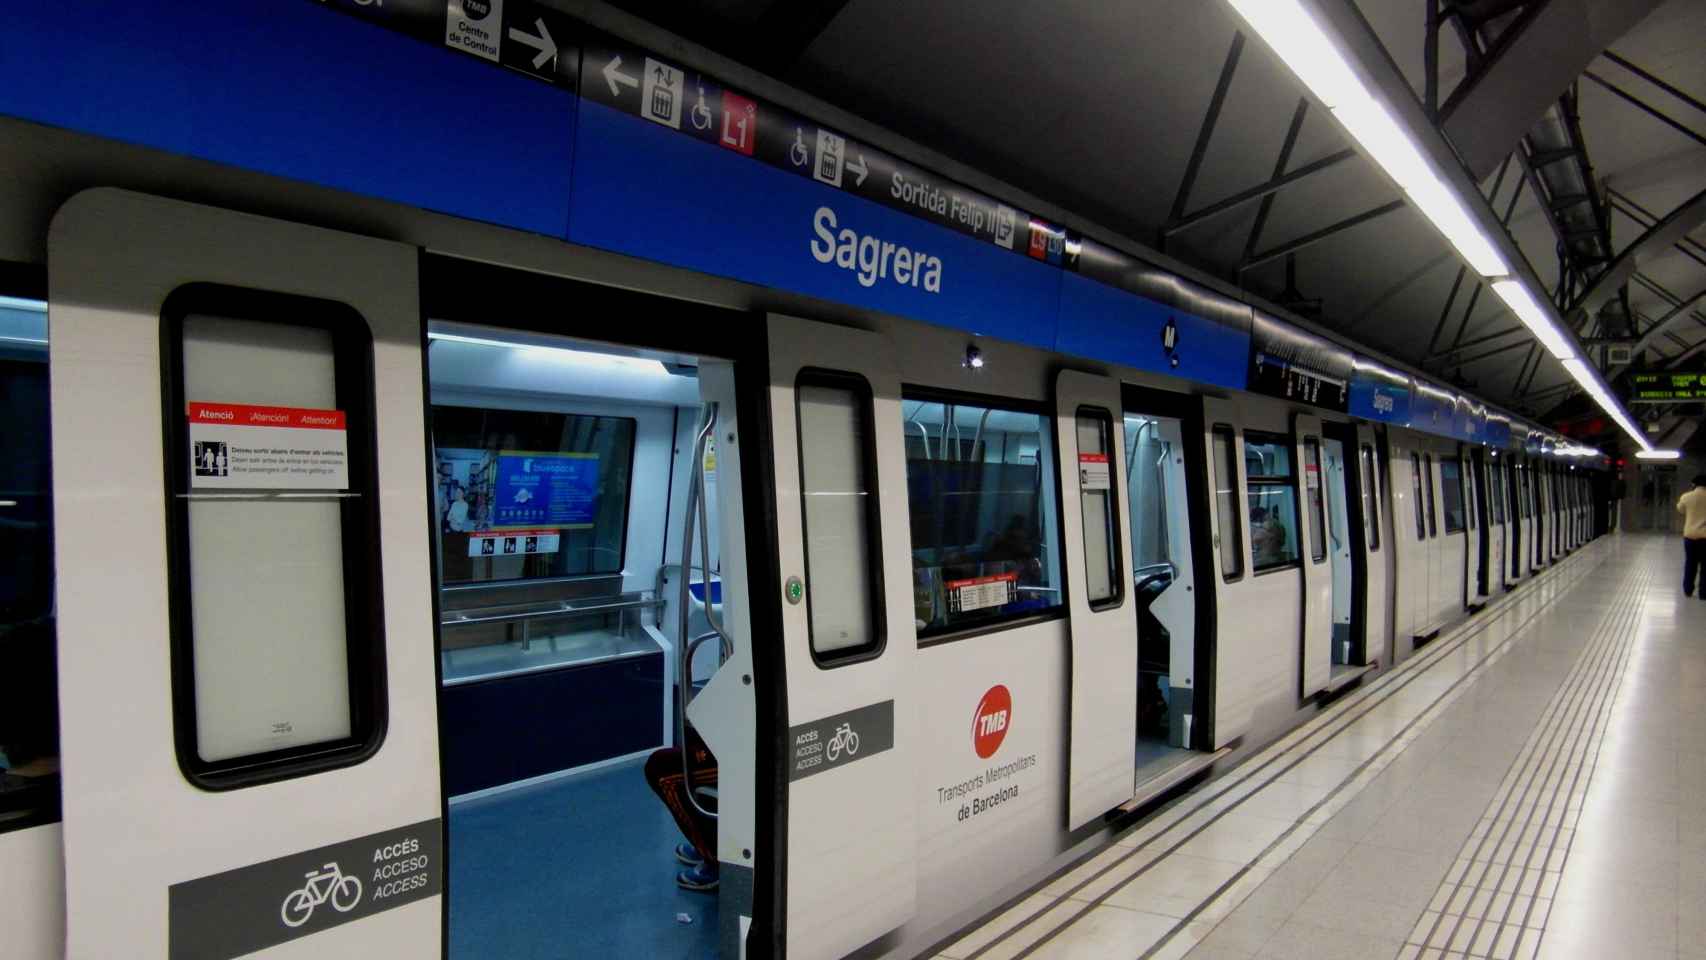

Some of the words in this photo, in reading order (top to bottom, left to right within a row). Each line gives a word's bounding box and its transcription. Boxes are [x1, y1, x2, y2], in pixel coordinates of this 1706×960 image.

[449, 32, 461, 43] de
[464, 36, 497, 56] Control
[458, 21, 489, 40] Centre
[723, 111, 747, 148] L1
[891, 172, 946, 215] Sortida
[951, 196, 984, 232] Felip
[811, 207, 943, 294] Sagrera
[979, 710, 1007, 737] TMB
[937, 773, 983, 803] Transports
[985, 754, 1036, 785] Metropolitans
[957, 803, 970, 822] de
[972, 784, 1018, 815] Barcelona
[373, 838, 419, 862] ACCÉS
[372, 854, 428, 882] ACCESO
[372, 873, 427, 901] ACCESS
